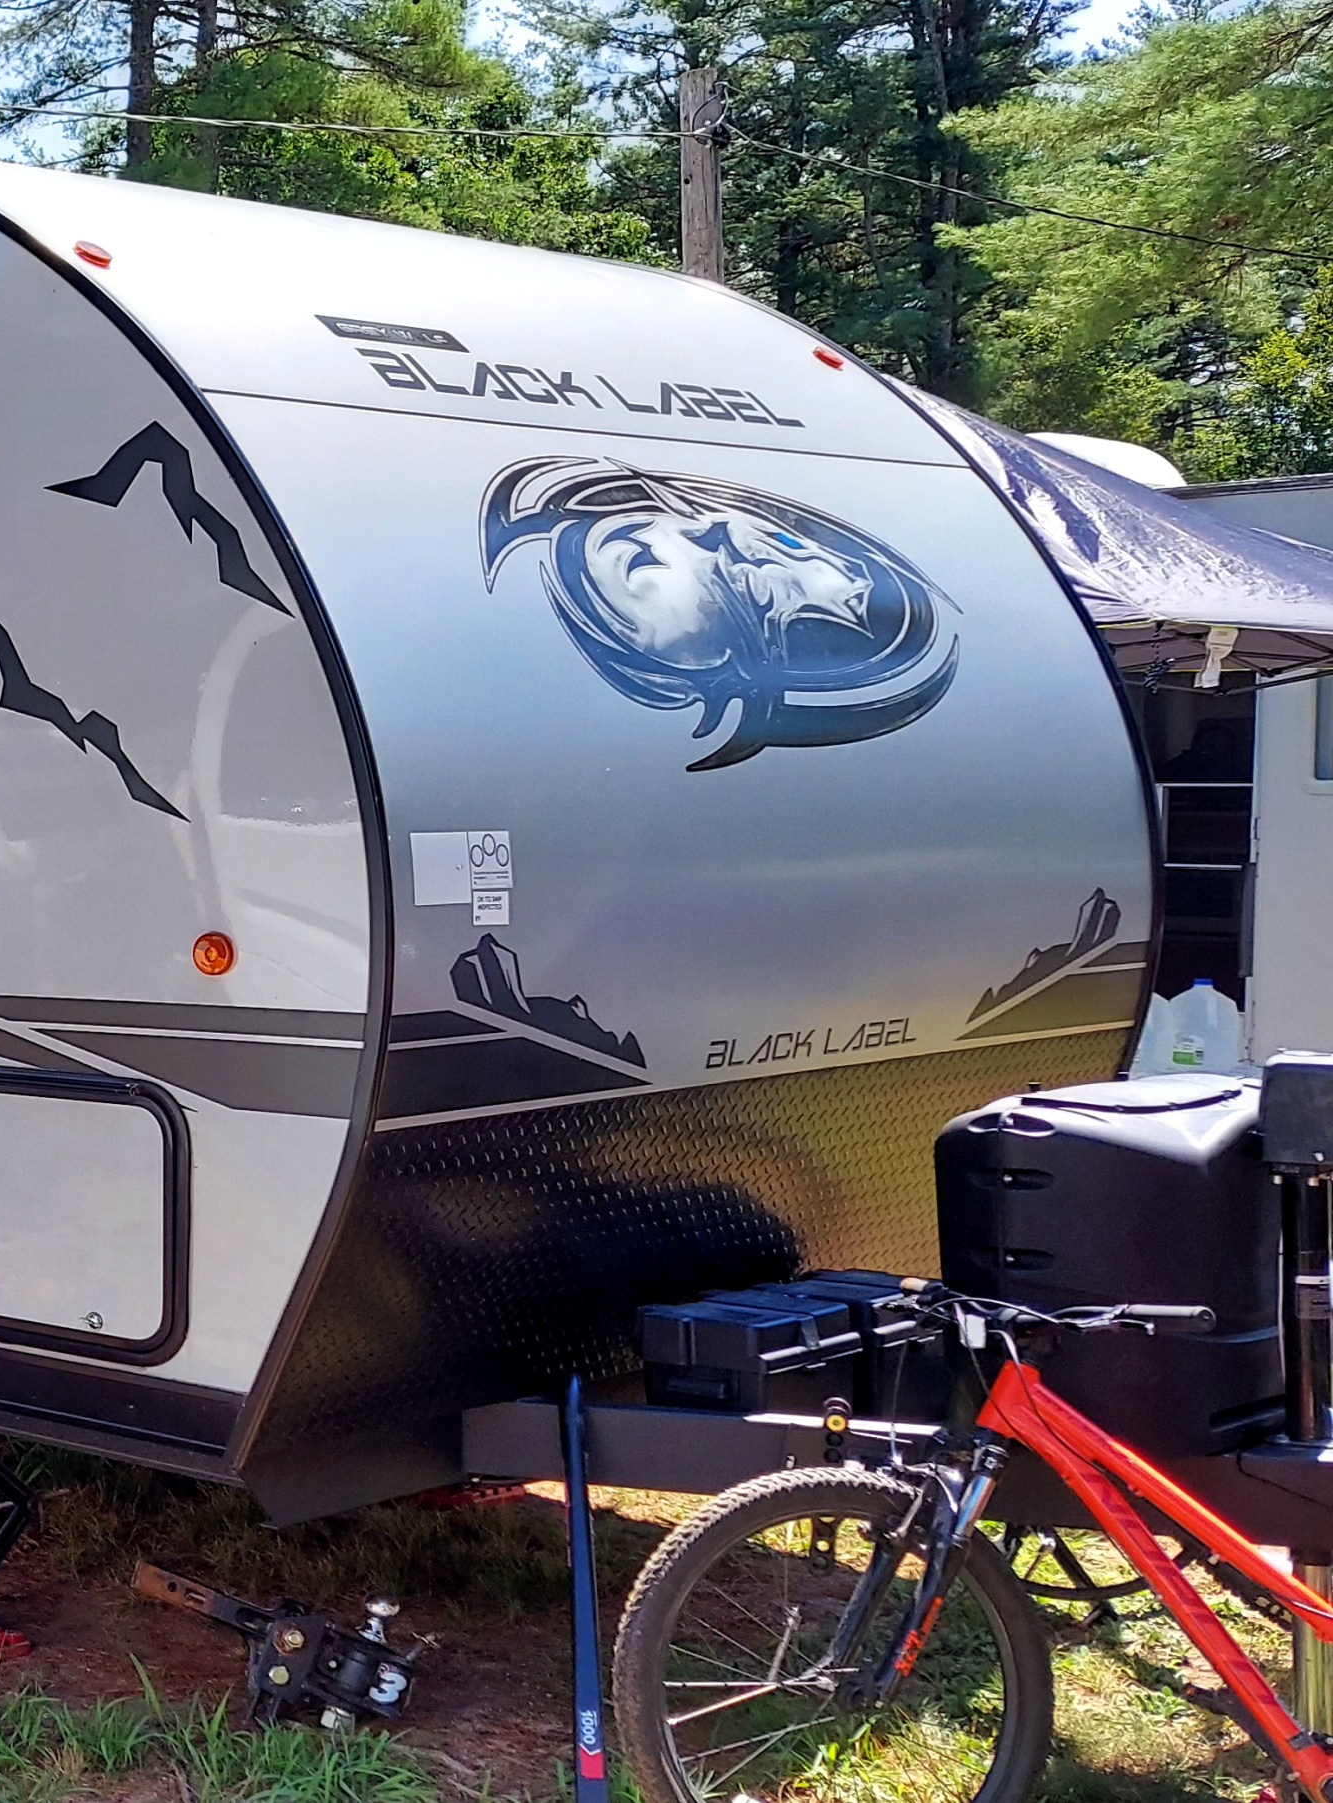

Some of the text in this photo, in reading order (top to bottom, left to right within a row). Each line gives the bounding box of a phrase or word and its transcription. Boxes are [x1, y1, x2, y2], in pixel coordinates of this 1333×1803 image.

[392, 329, 449, 345] WLF
[354, 347, 806, 428] BLACK LABEL
[705, 1017, 917, 1070] BLACK LABEL
[368, 1671, 408, 1702] 3
[579, 1710, 595, 1745] 1000
